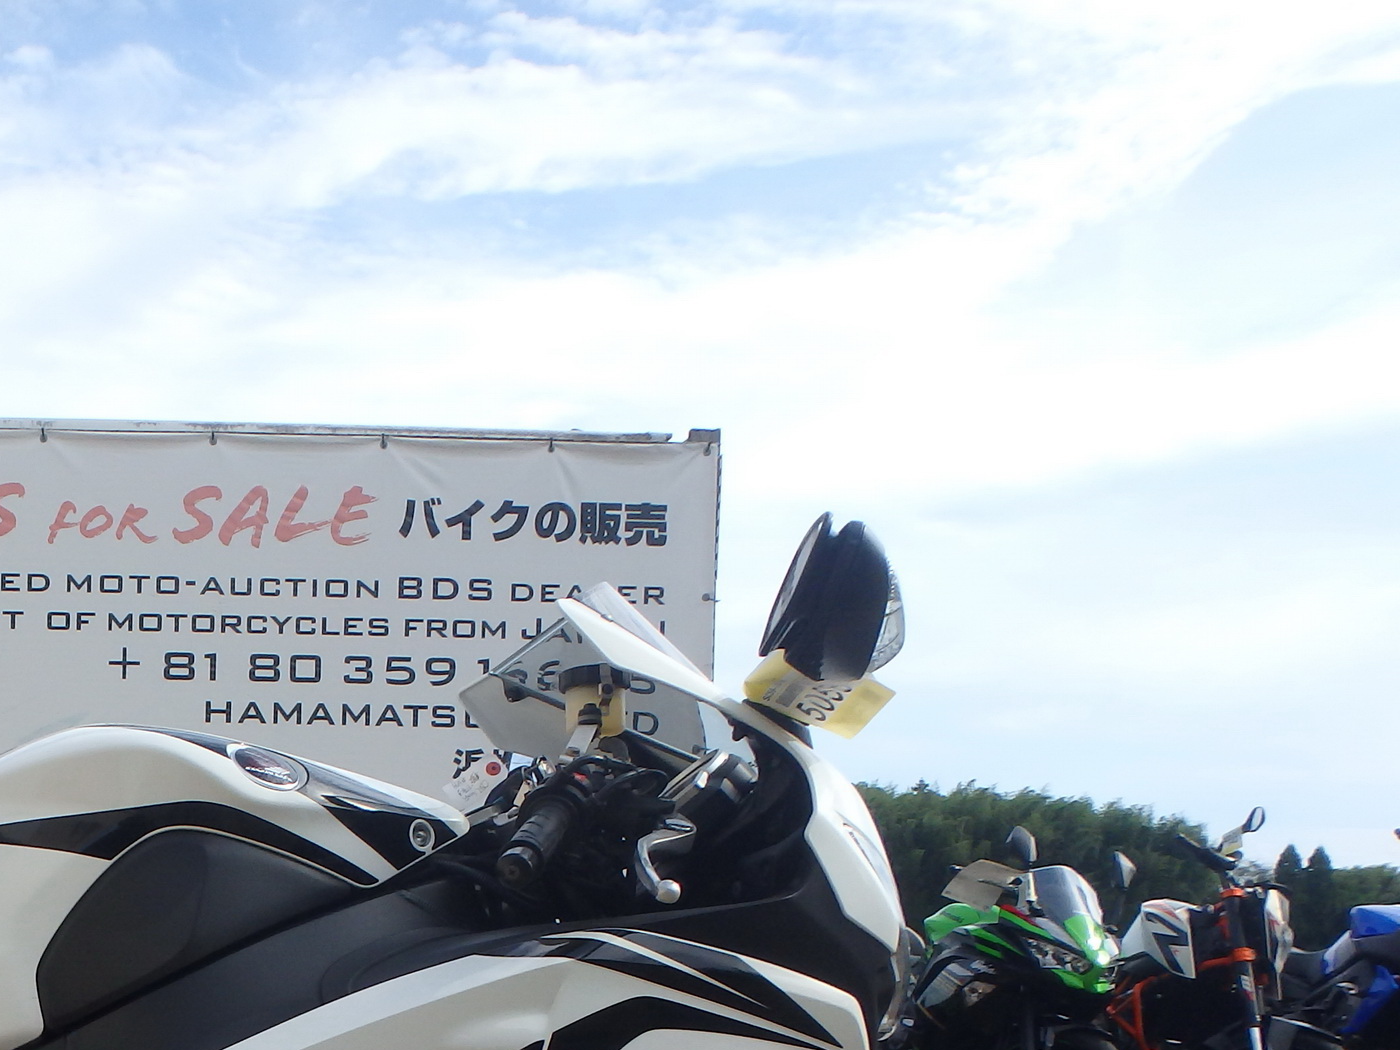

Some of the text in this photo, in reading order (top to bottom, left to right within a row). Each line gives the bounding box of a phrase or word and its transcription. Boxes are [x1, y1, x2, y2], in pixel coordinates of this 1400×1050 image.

[172, 485, 379, 548] SALE
[399, 497, 668, 546] バイクの販売
[66, 573, 380, 598] MOTO-AUCTION
[398, 576, 493, 601] BDS
[510, 583, 665, 606] DEAER
[46, 611, 96, 631] OF
[108, 612, 389, 637] MOTORCYCLES
[404, 618, 506, 639] FROM
[163, 652, 218, 681] 81
[248, 653, 322, 683] 80
[343, 655, 456, 687] 359
